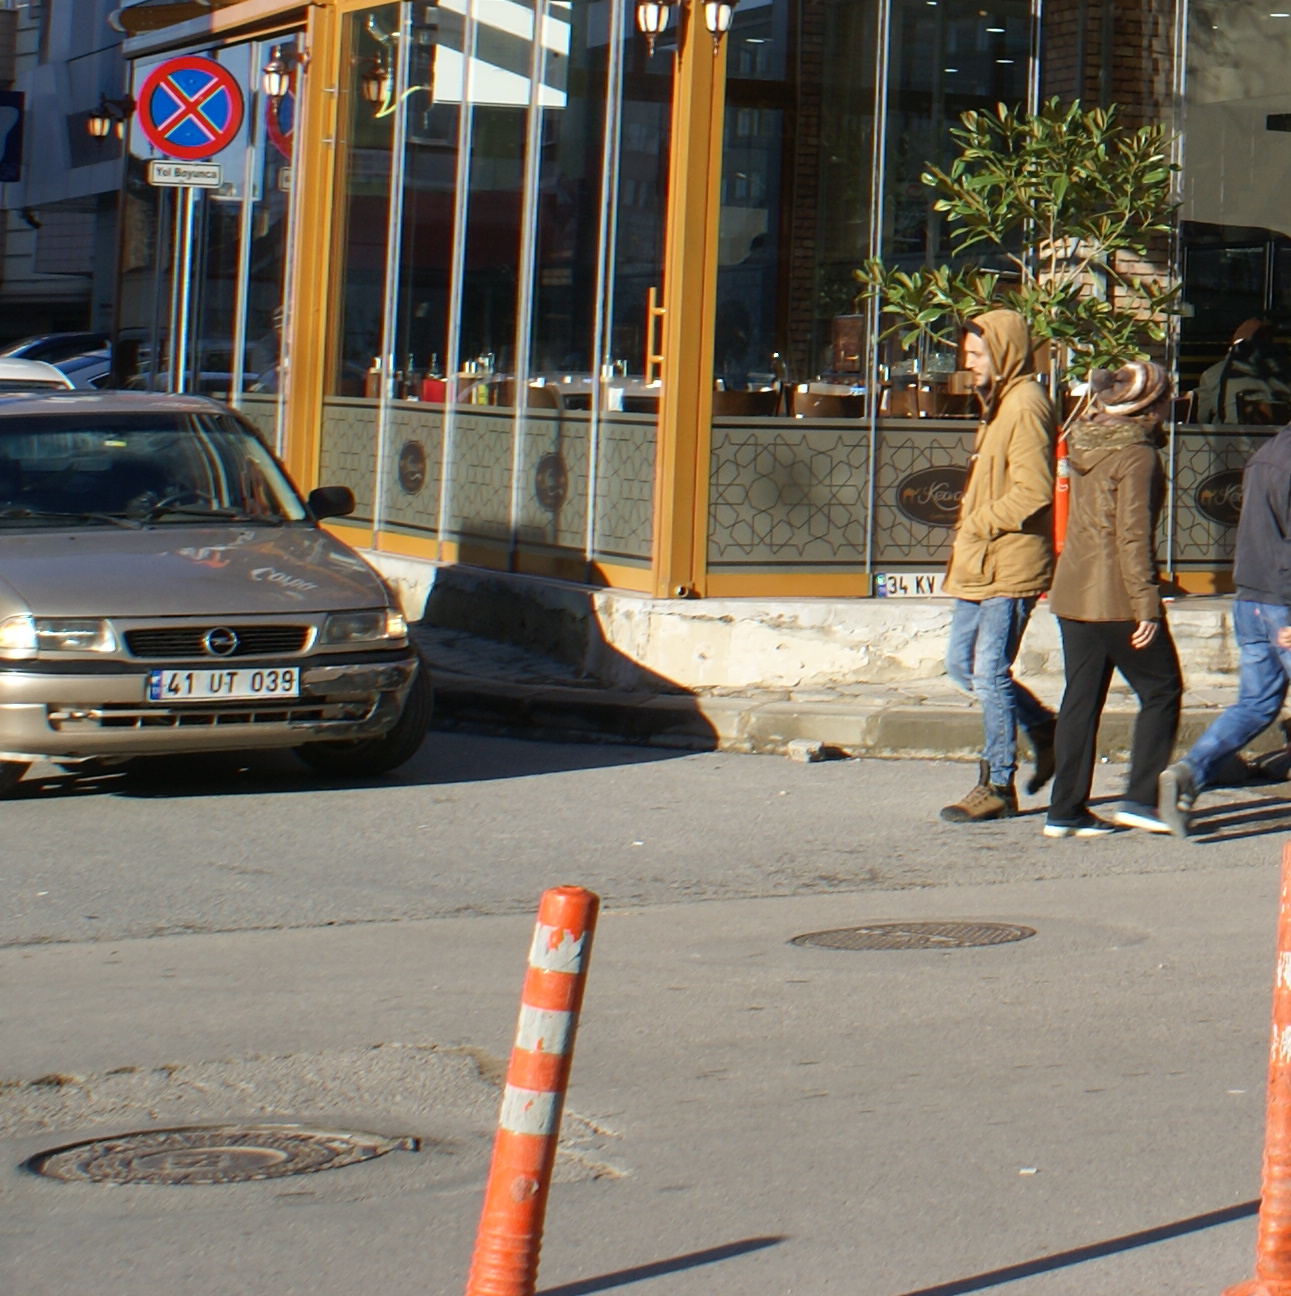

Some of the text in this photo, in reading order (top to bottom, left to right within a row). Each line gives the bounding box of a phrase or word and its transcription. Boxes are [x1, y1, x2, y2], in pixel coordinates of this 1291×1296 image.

[156, 167, 217, 180] Yol Boyunca
[887, 575, 936, 595] 34 KV
[167, 670, 294, 695] 41 UT 039
